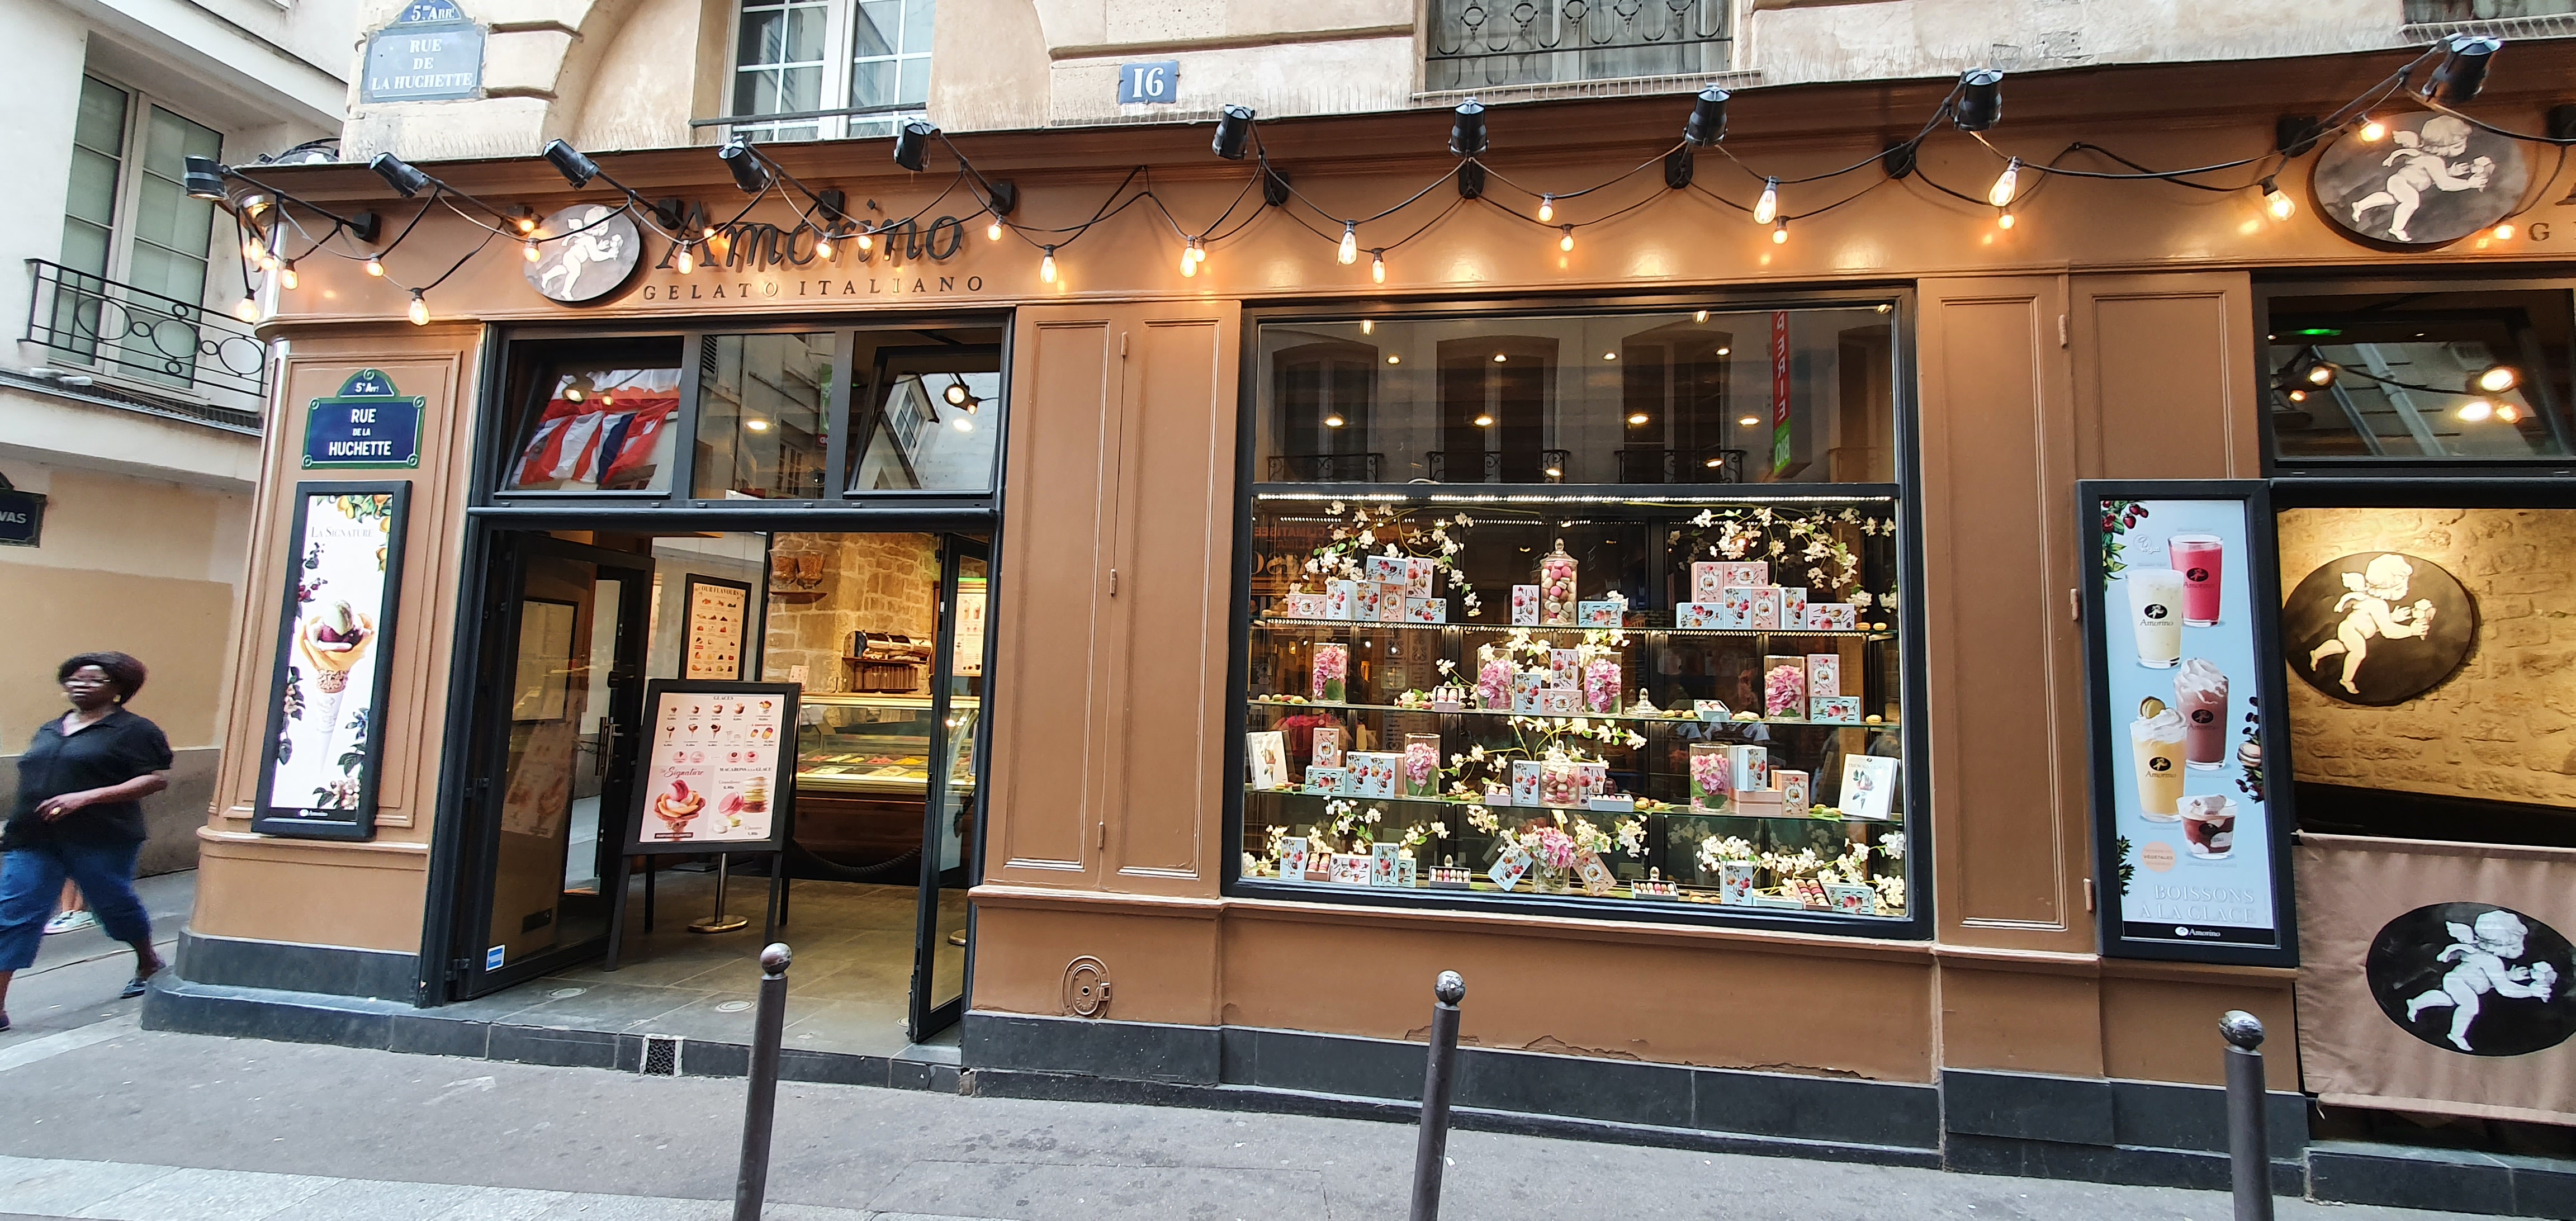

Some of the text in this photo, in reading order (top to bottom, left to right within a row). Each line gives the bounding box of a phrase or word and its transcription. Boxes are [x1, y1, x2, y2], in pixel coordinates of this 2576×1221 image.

[410, 39, 442, 53] RUE
[413, 58, 434, 70] DE
[372, 73, 473, 90] LA HUCHETTE
[1132, 67, 1164, 98] 16
[655, 198, 963, 269] Amorino
[643, 276, 983, 299] GELATO ITALIANO
[351, 409, 377, 423] RUE
[329, 441, 392, 456] HUCHETTE
[714, 587, 740, 596] FLAVOURS
[664, 766, 704, 779] Signature
[2154, 884, 2255, 904] BOISSONS
[2141, 900, 2256, 924] À LA GLACE
[2189, 928, 2221, 937] Amorino
